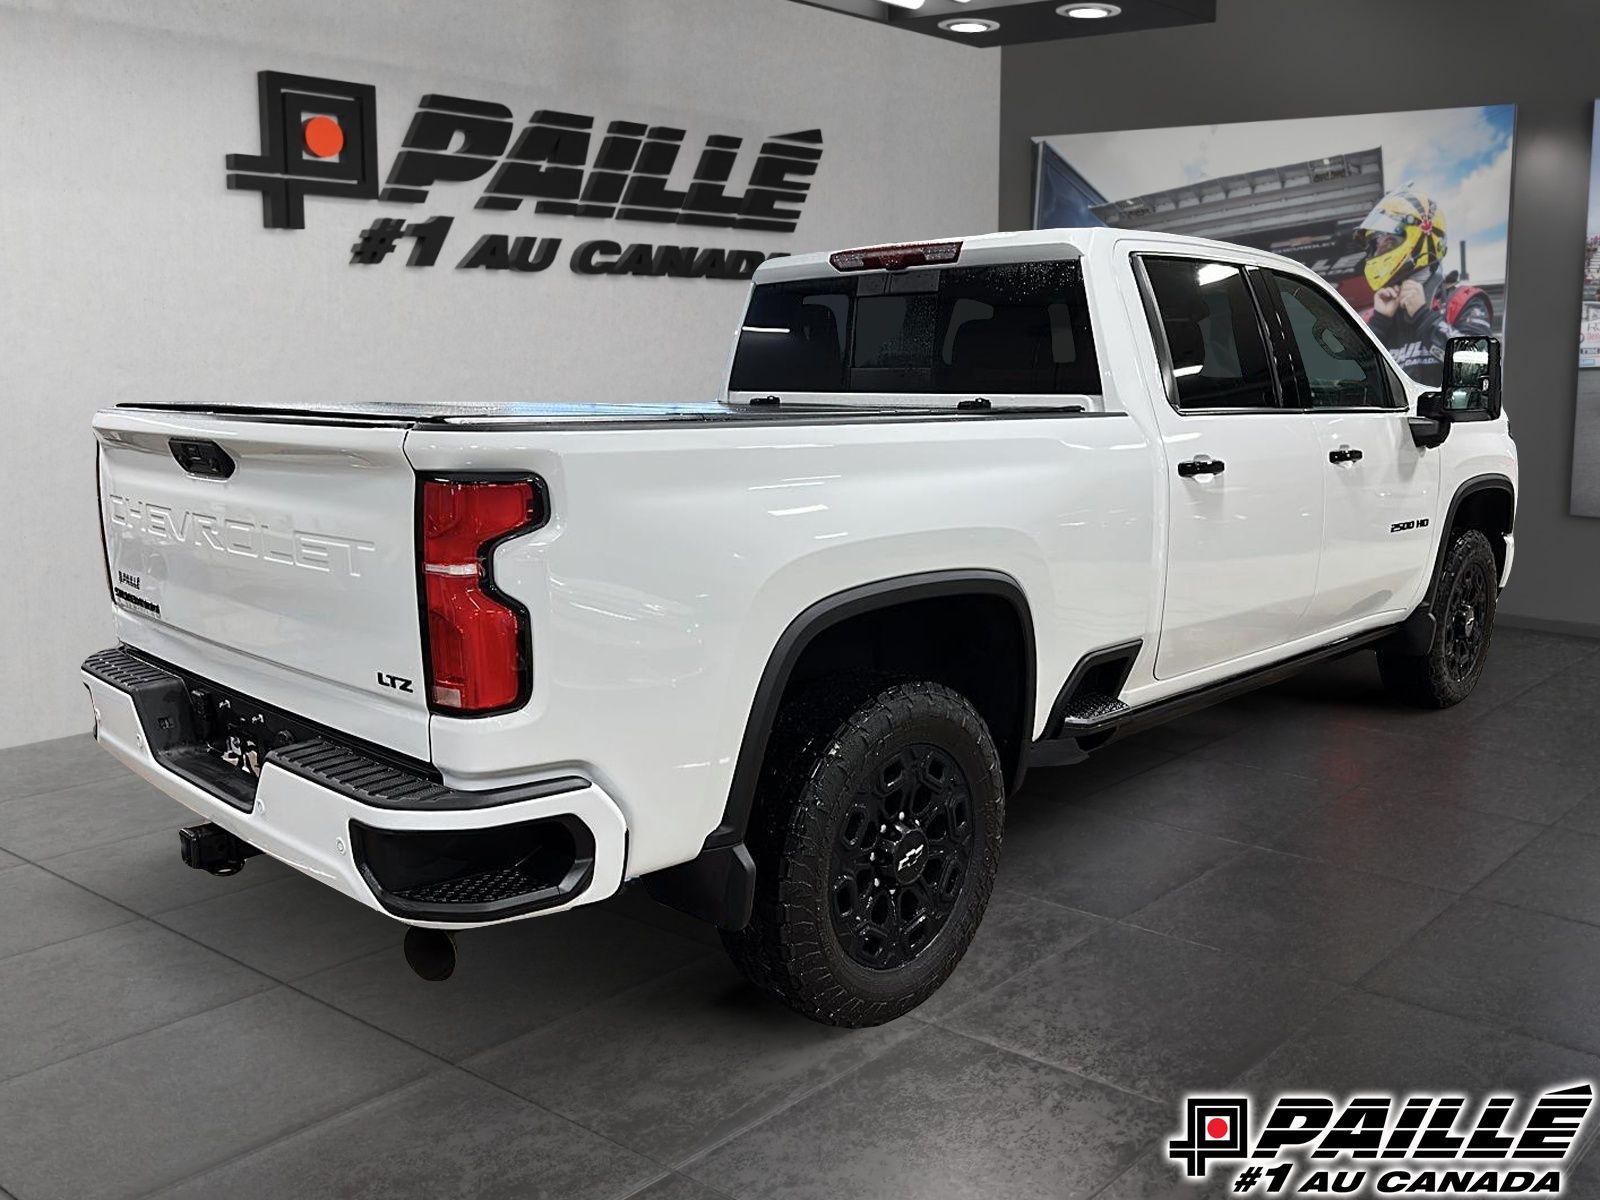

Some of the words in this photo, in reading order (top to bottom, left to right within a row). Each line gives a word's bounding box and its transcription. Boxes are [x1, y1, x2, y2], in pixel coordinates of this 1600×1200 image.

[378, 93, 823, 233] PAILLÉ
[349, 215, 455, 267] #1
[455, 234, 562, 273] AU
[570, 239, 791, 279] CANAD
[109, 493, 376, 577] CHEVROLET
[1390, 520, 1415, 533] 2500
[377, 671, 414, 694] LTZ
